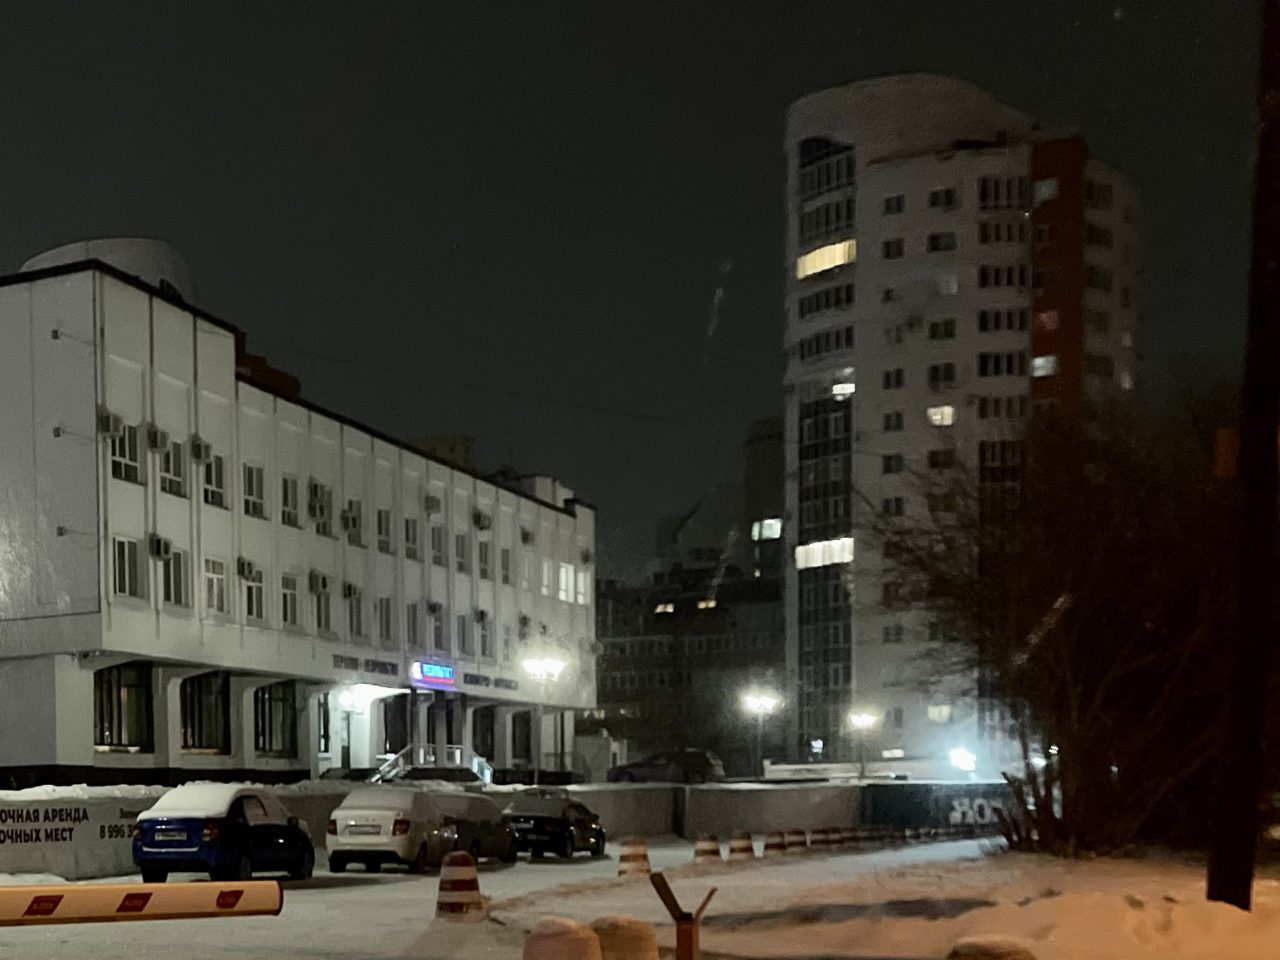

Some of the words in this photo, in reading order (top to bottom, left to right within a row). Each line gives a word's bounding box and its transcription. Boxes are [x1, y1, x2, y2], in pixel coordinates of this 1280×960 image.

[43, 807, 90, 824] АРЕНДА
[45, 827, 74, 842] МЕСТ
[99, 824, 106, 839] 8
[107, 824, 126, 839] 996
